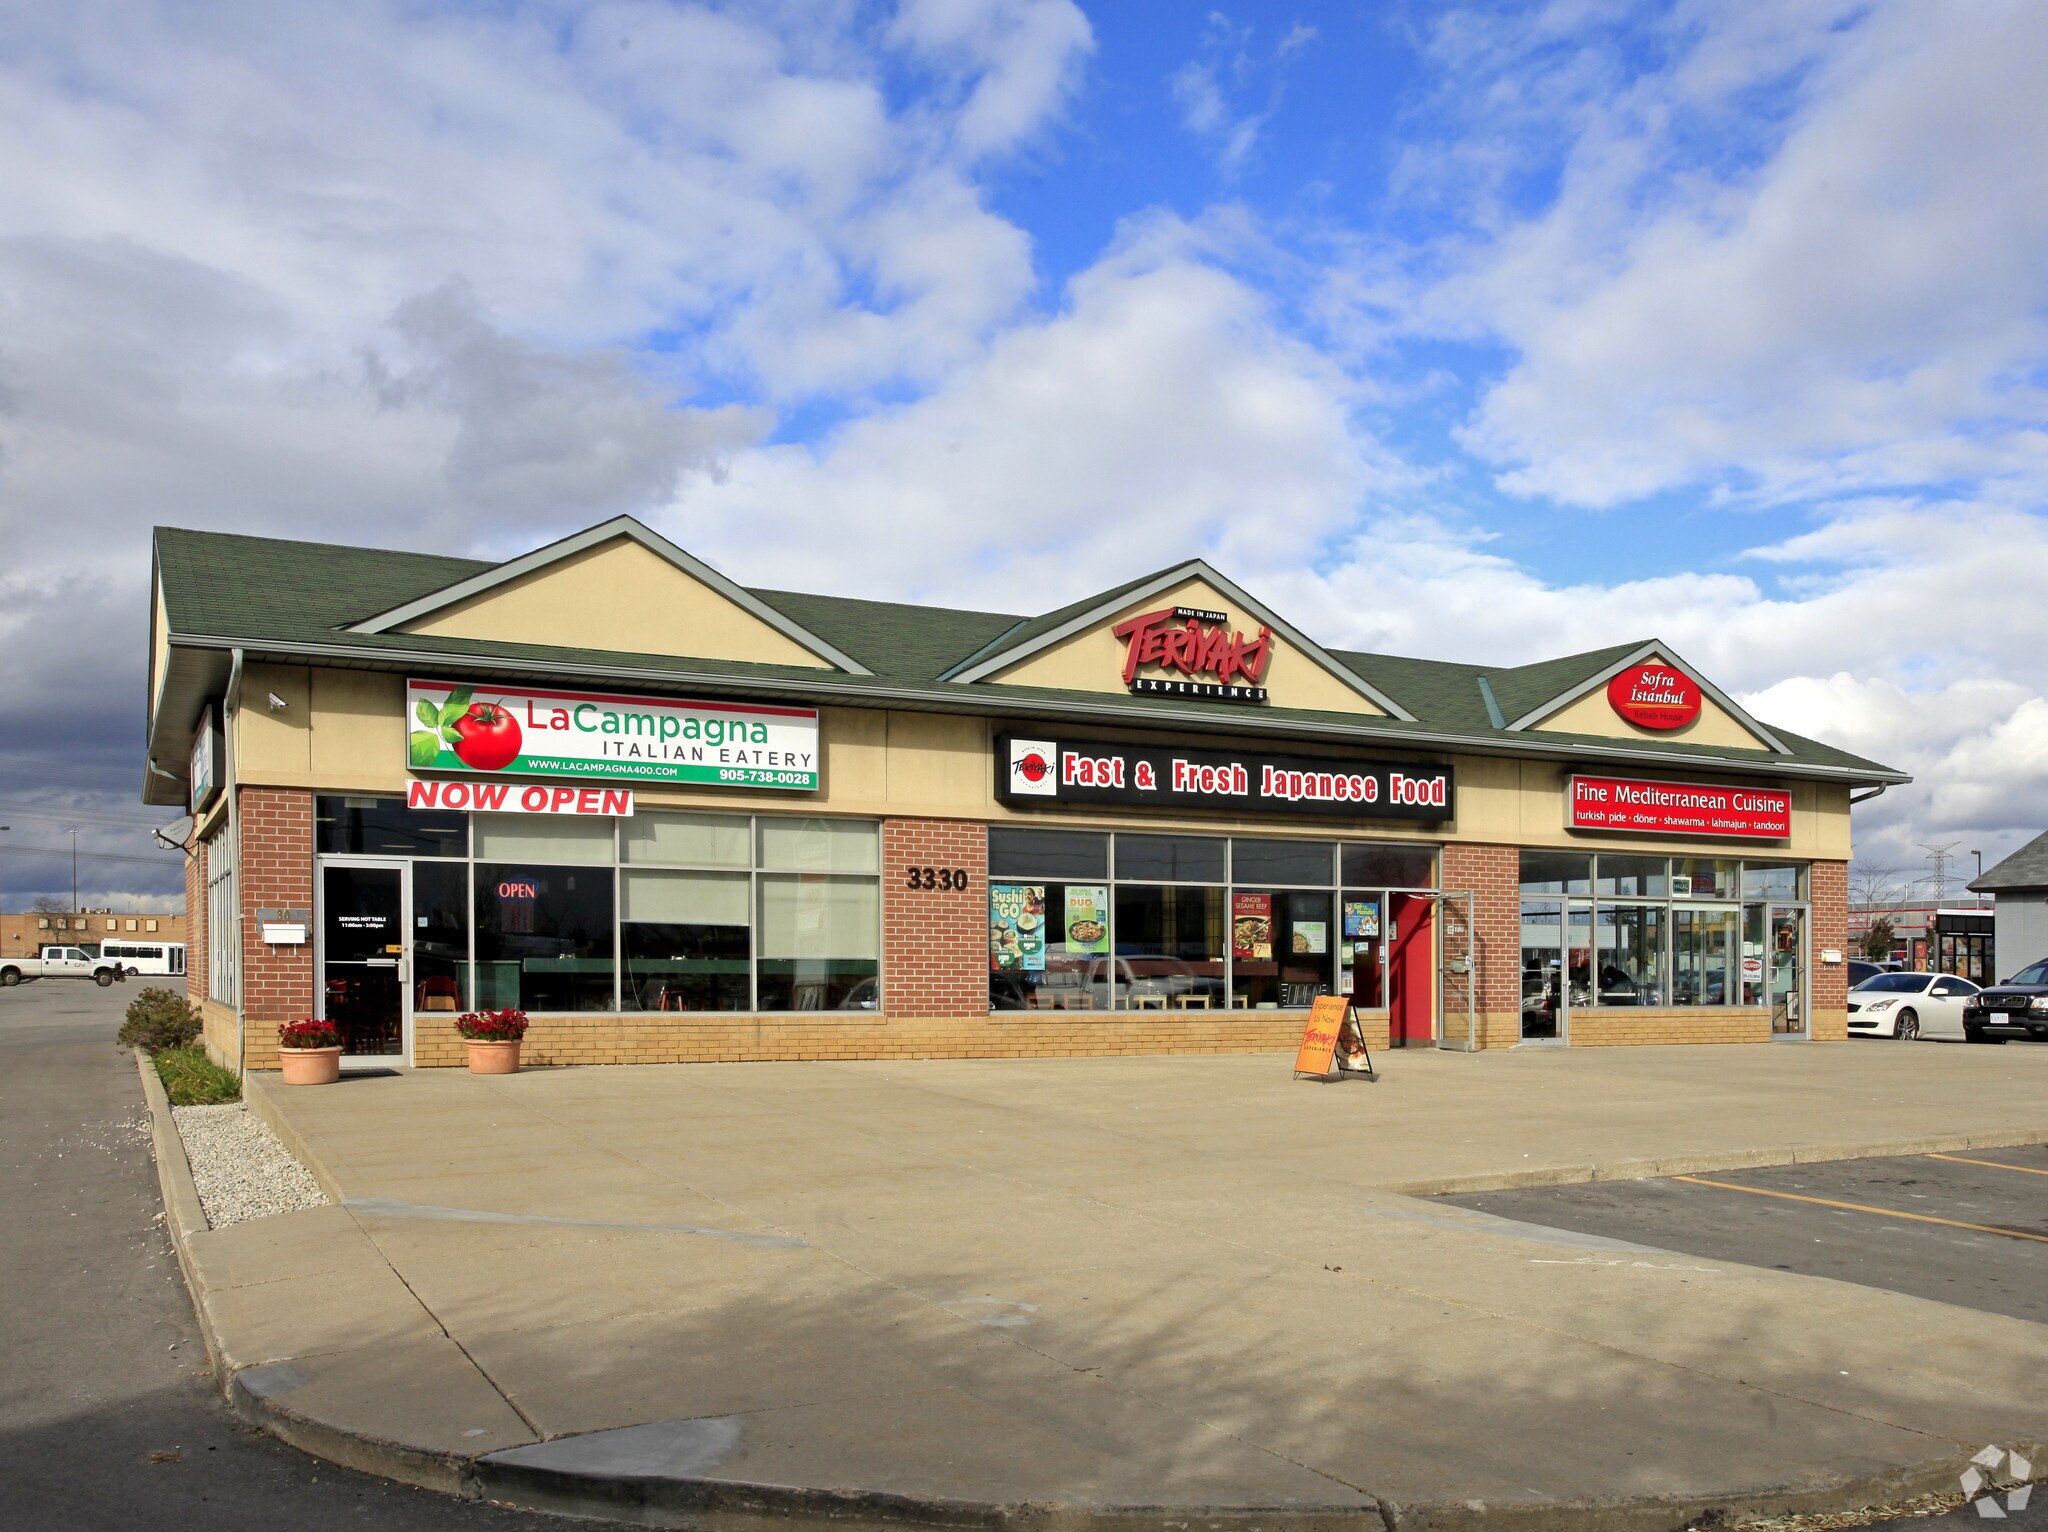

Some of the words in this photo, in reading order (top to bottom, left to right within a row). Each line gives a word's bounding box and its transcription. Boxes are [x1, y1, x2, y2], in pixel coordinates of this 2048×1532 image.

[1177, 608, 1195, 617] MADE
[1196, 610, 1204, 618] IN
[1205, 611, 1226, 621] JAPAN
[1136, 679, 1265, 699] EXPERIENCE
[1640, 671, 1675, 690] Sofra
[1660, 711, 1683, 722] House
[602, 740, 704, 762] ITALIAN
[719, 748, 813, 768] EATERY
[527, 759, 678, 777] WWW.LACAMPAGNA400.COM
[718, 768, 811, 786] 905-738-0028
[1063, 752, 1125, 790] Fast
[1135, 761, 1158, 791] &
[1172, 759, 1249, 796] Fresh
[1261, 766, 1379, 801] Japanese
[1390, 773, 1447, 806] Food
[408, 781, 511, 811] NOW
[520, 786, 632, 815] OPEN
[1576, 782, 1608, 803] Fine
[1615, 785, 1727, 811] Mediterranean
[1732, 793, 1785, 814] Cuisine
[1576, 810, 1606, 822] turkish
[1608, 812, 1627, 825] pide
[1633, 812, 1657, 824] döner
[1663, 815, 1705, 828] shawarma
[1711, 817, 1747, 831] lahmajun
[1753, 820, 1785, 831] tandoori
[907, 867, 968, 891] 3330
[498, 882, 535, 898] OPEN
[992, 888, 1023, 904] Sushi
[992, 902, 1000, 910] TO
[999, 902, 1020, 918] GO
[1069, 897, 1093, 907] DUO
[276, 909, 289, 920] 30
[1313, 1001, 1344, 1012] Experience
[1313, 1014, 1320, 1023] Us
[1321, 1014, 1336, 1024] Now
